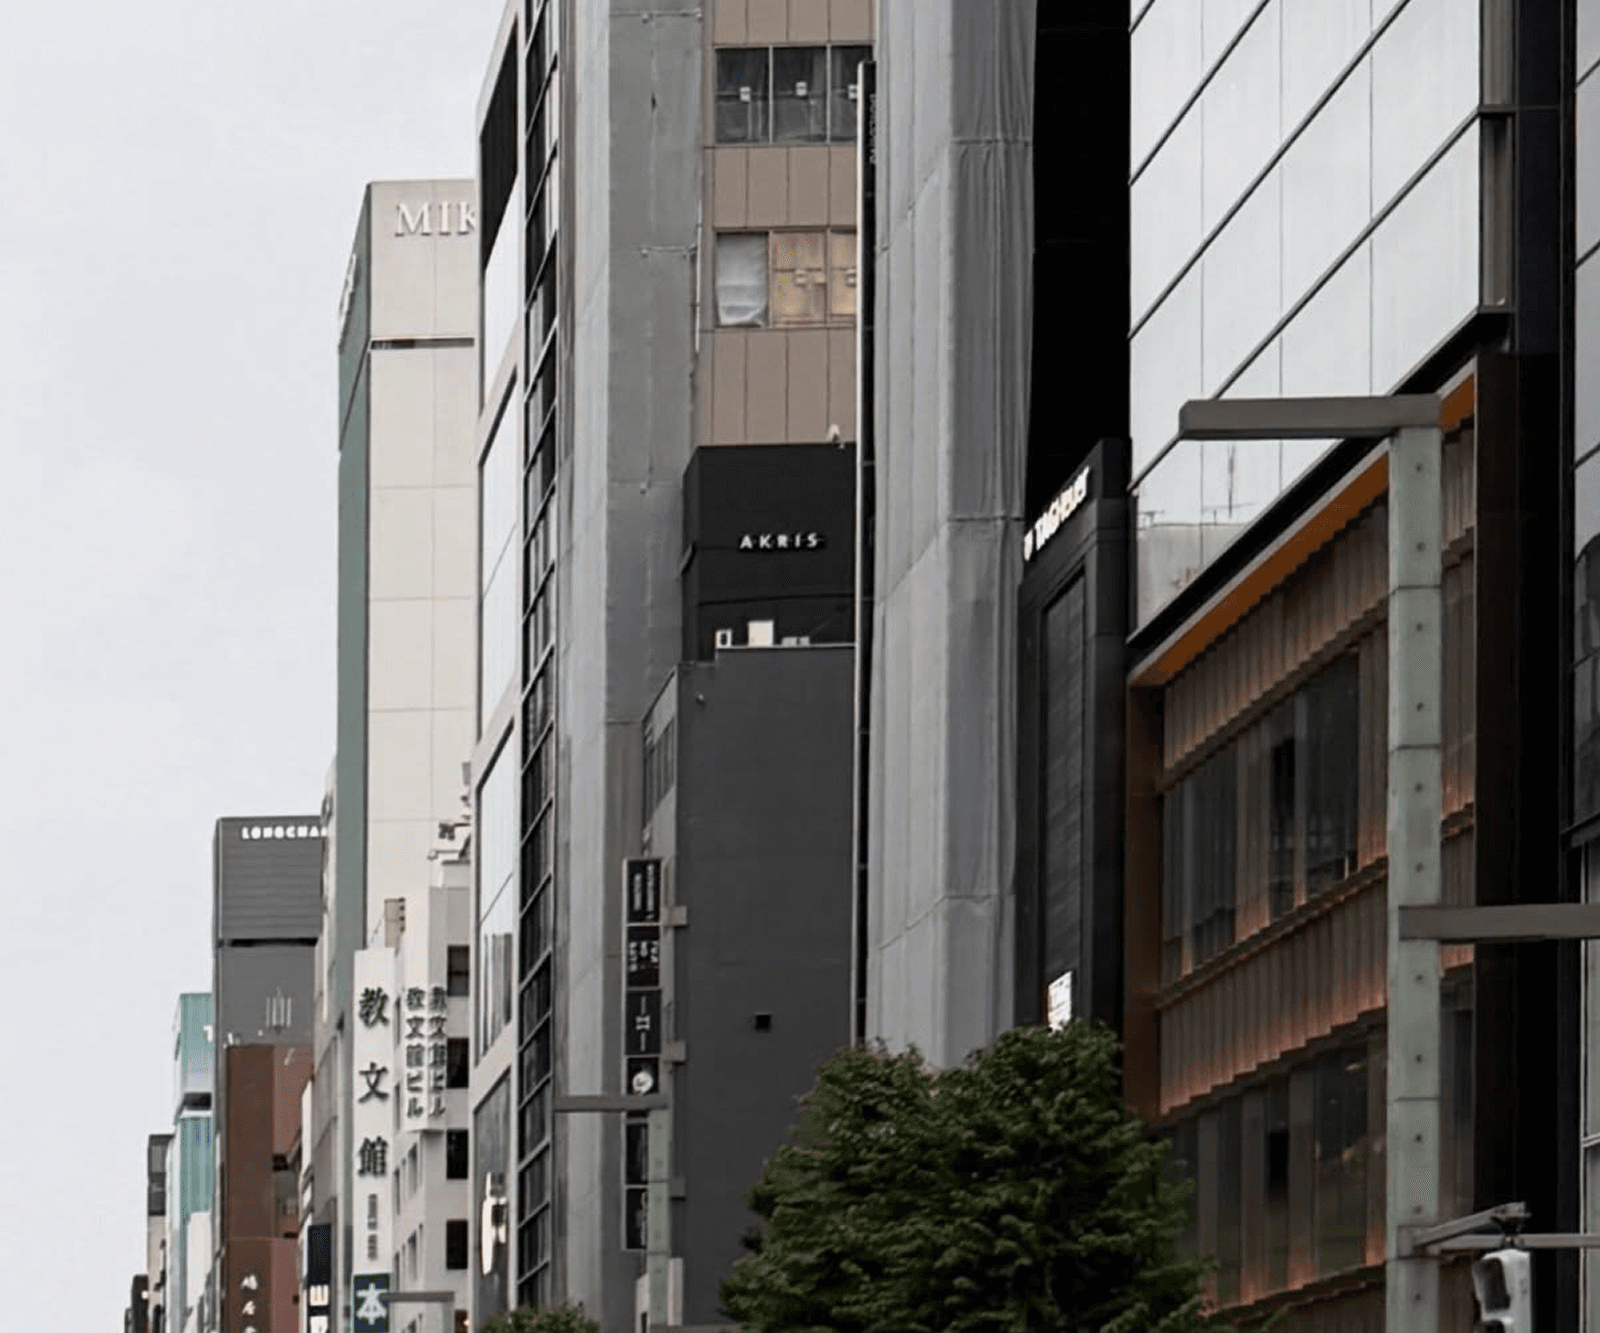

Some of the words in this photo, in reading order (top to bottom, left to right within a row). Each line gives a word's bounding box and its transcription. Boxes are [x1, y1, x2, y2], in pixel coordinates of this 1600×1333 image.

[739, 532, 818, 549] AKRIS
[358, 986, 389, 1177] 教文館
[356, 1282, 388, 1326] 本
